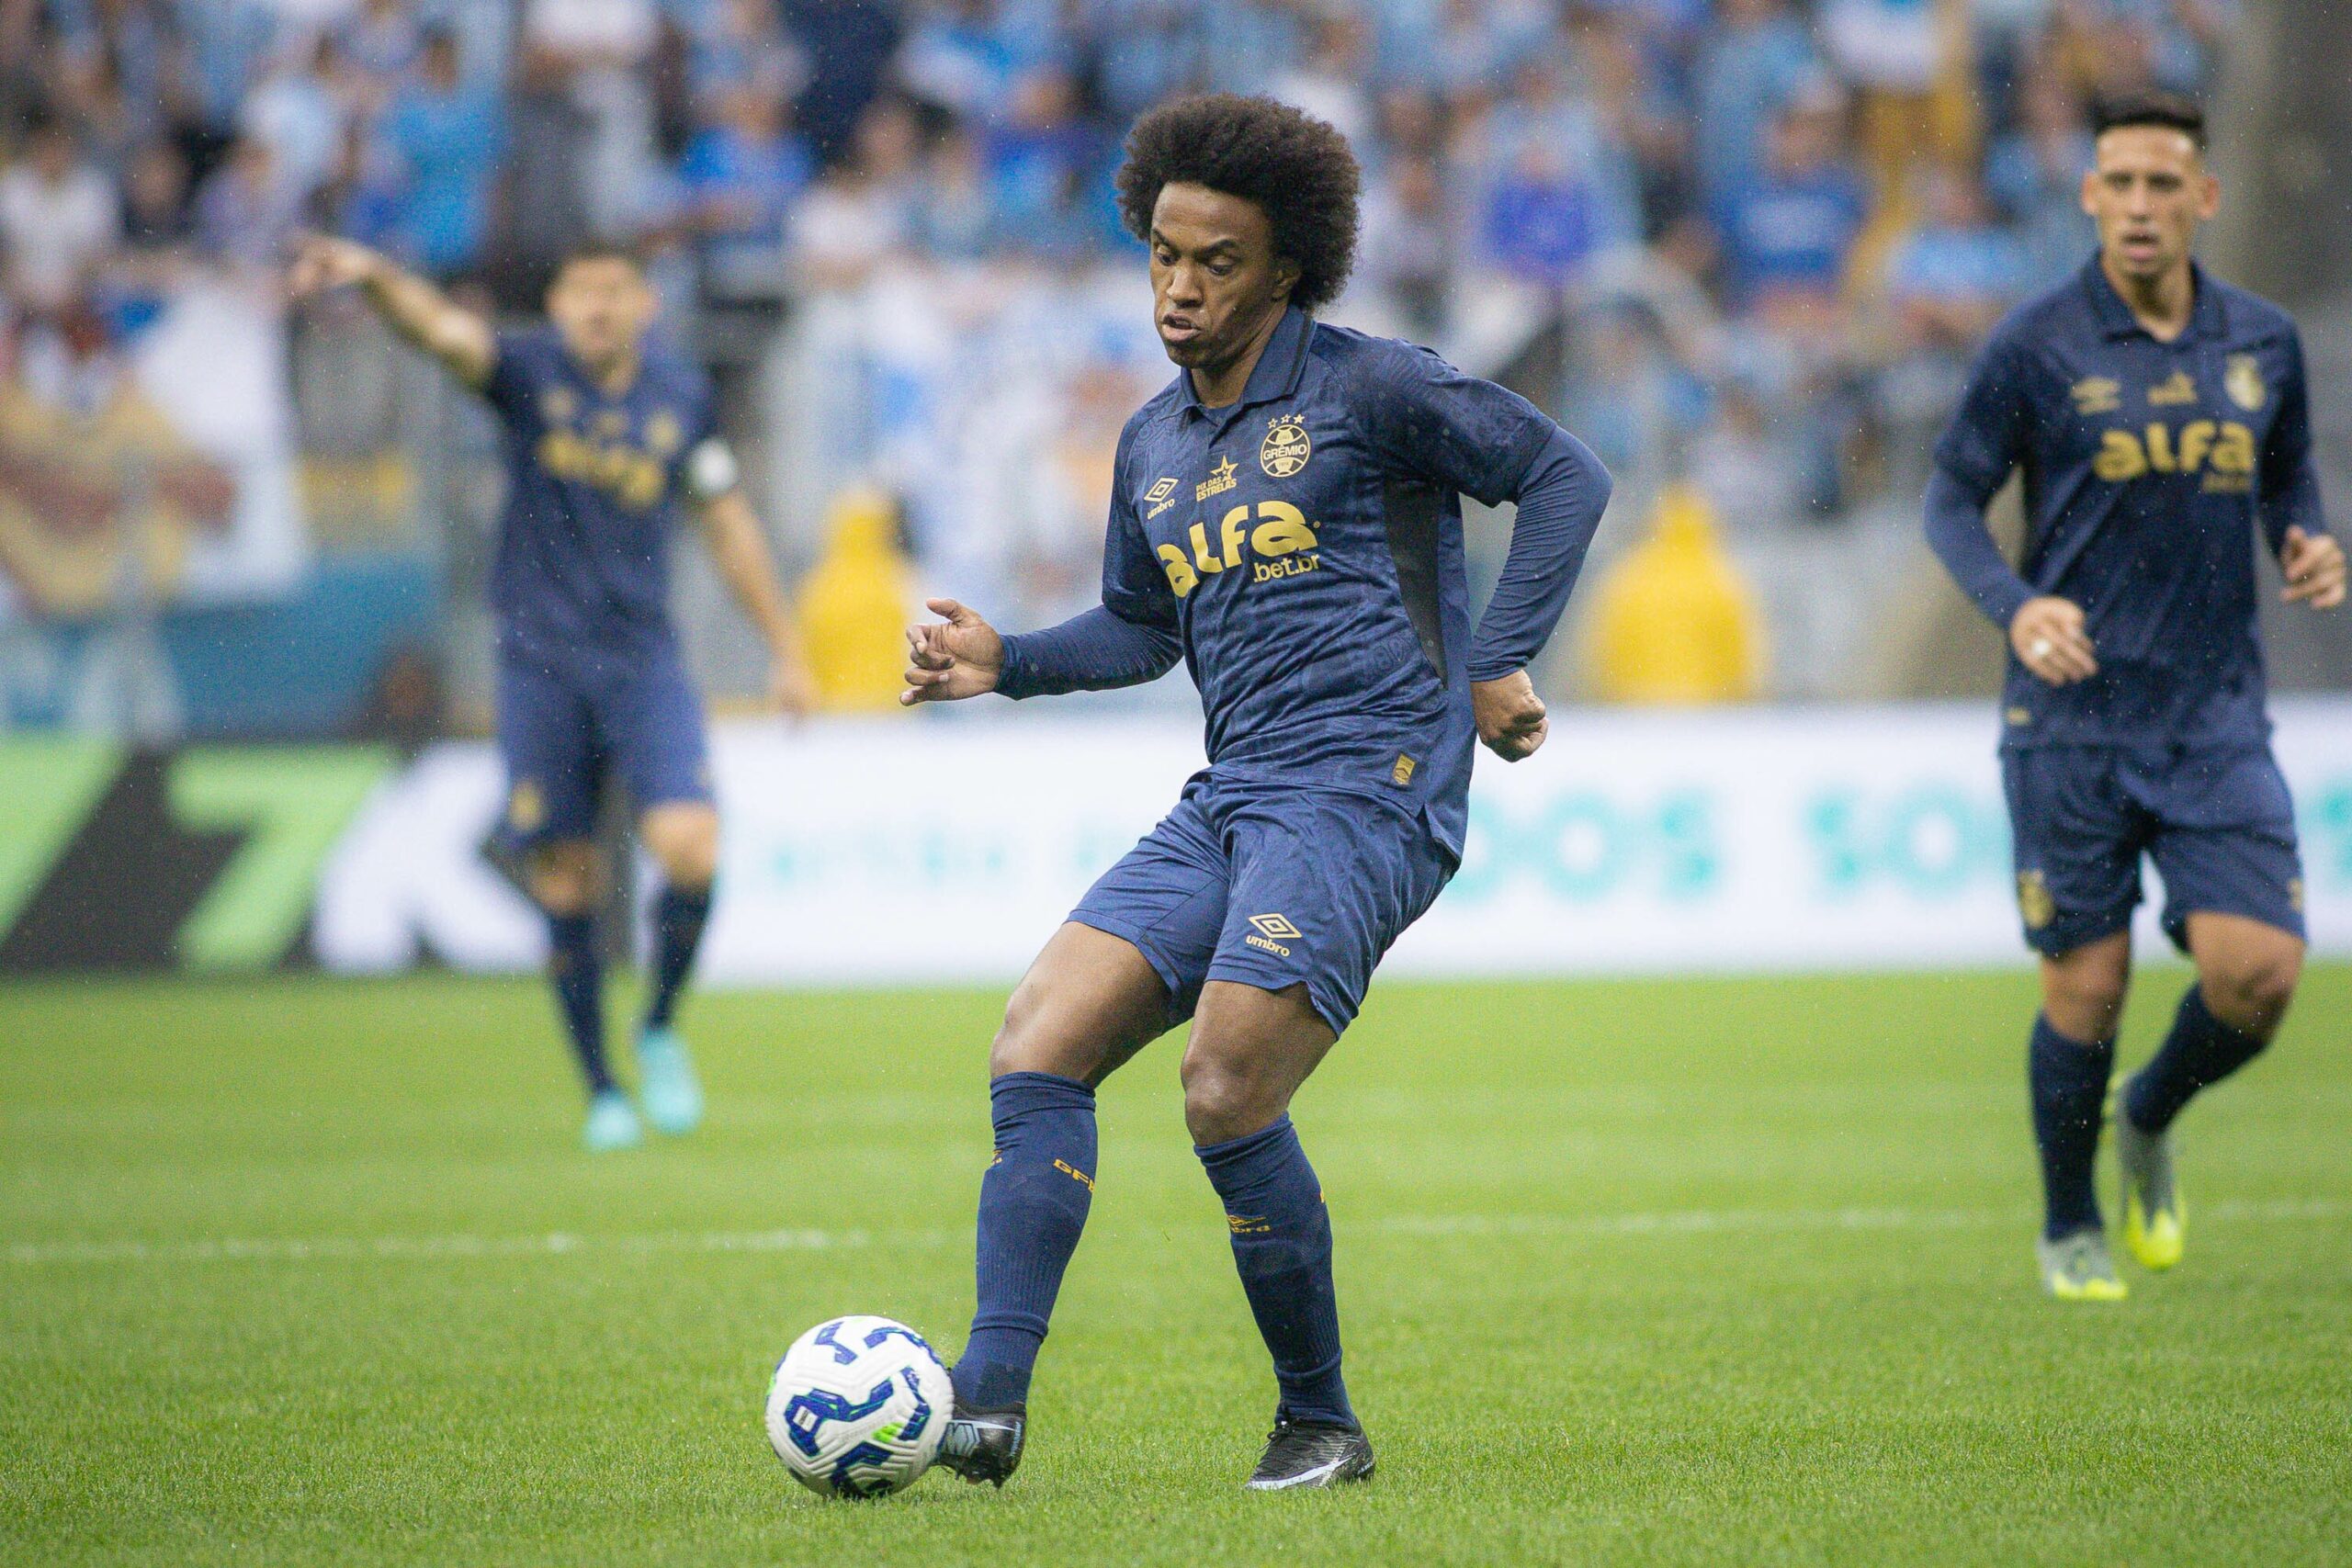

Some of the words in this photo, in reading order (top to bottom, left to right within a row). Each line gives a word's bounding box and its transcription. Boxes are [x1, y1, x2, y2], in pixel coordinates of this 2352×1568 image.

[1263, 443, 1307, 460] GRÊMIO
[1196, 478, 1237, 502] ESTRELAS
[1148, 498, 1175, 520] umbro
[1253, 553, 1320, 582] .bet.br
[1246, 935, 1290, 957] umbro
